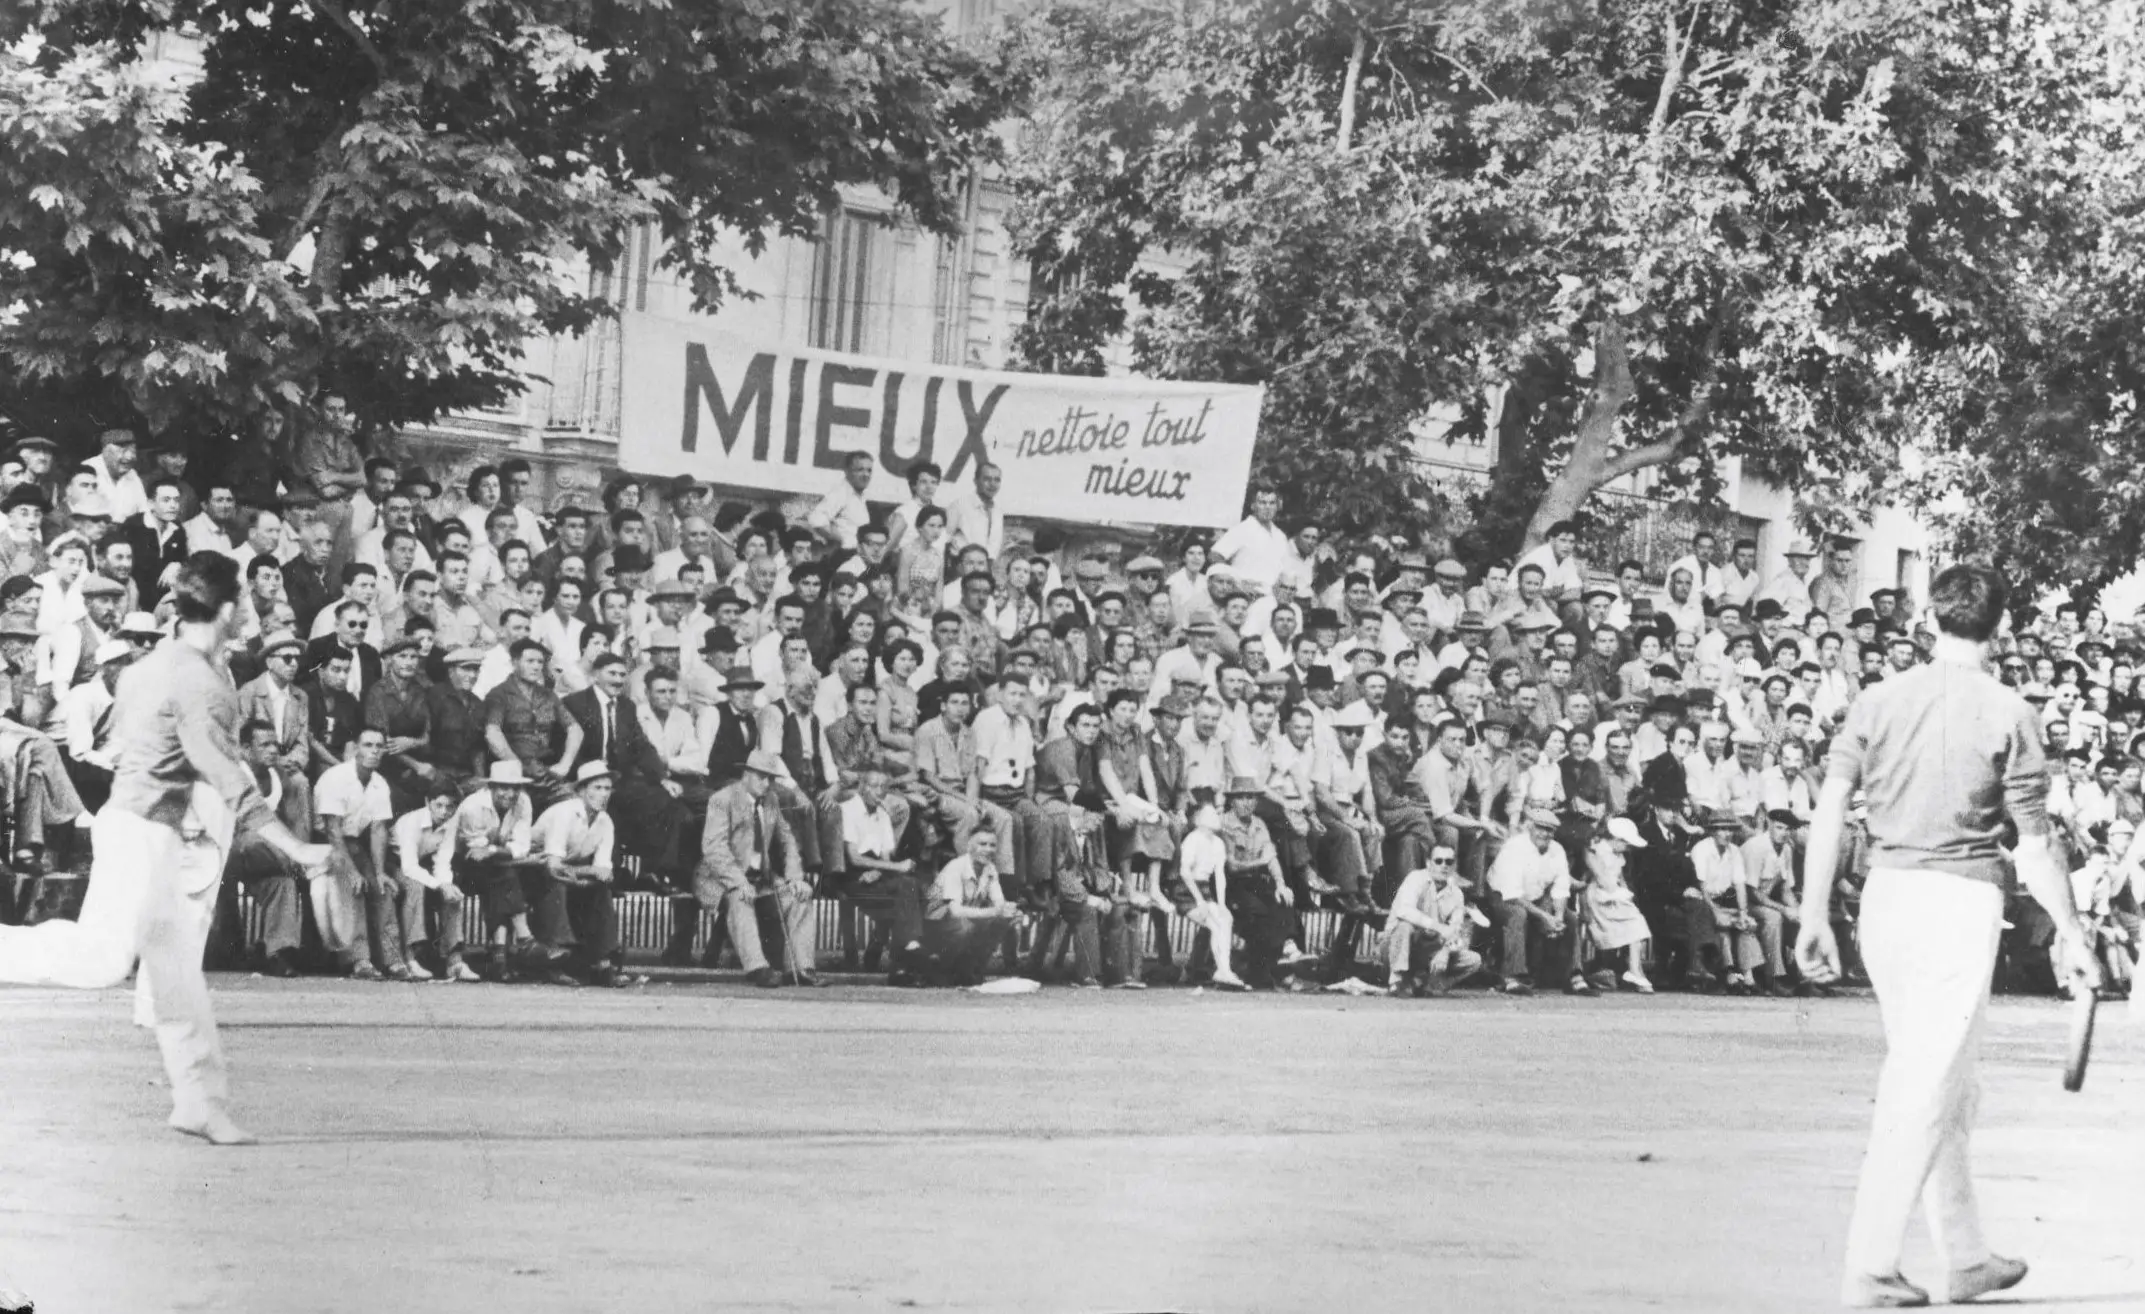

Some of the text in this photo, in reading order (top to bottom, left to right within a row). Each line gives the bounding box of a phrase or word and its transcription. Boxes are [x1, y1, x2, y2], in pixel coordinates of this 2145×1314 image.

[681, 341, 1011, 483] MIEUX
[1017, 398, 1214, 459] nettoie tout
[1084, 457, 1192, 501] mieux
